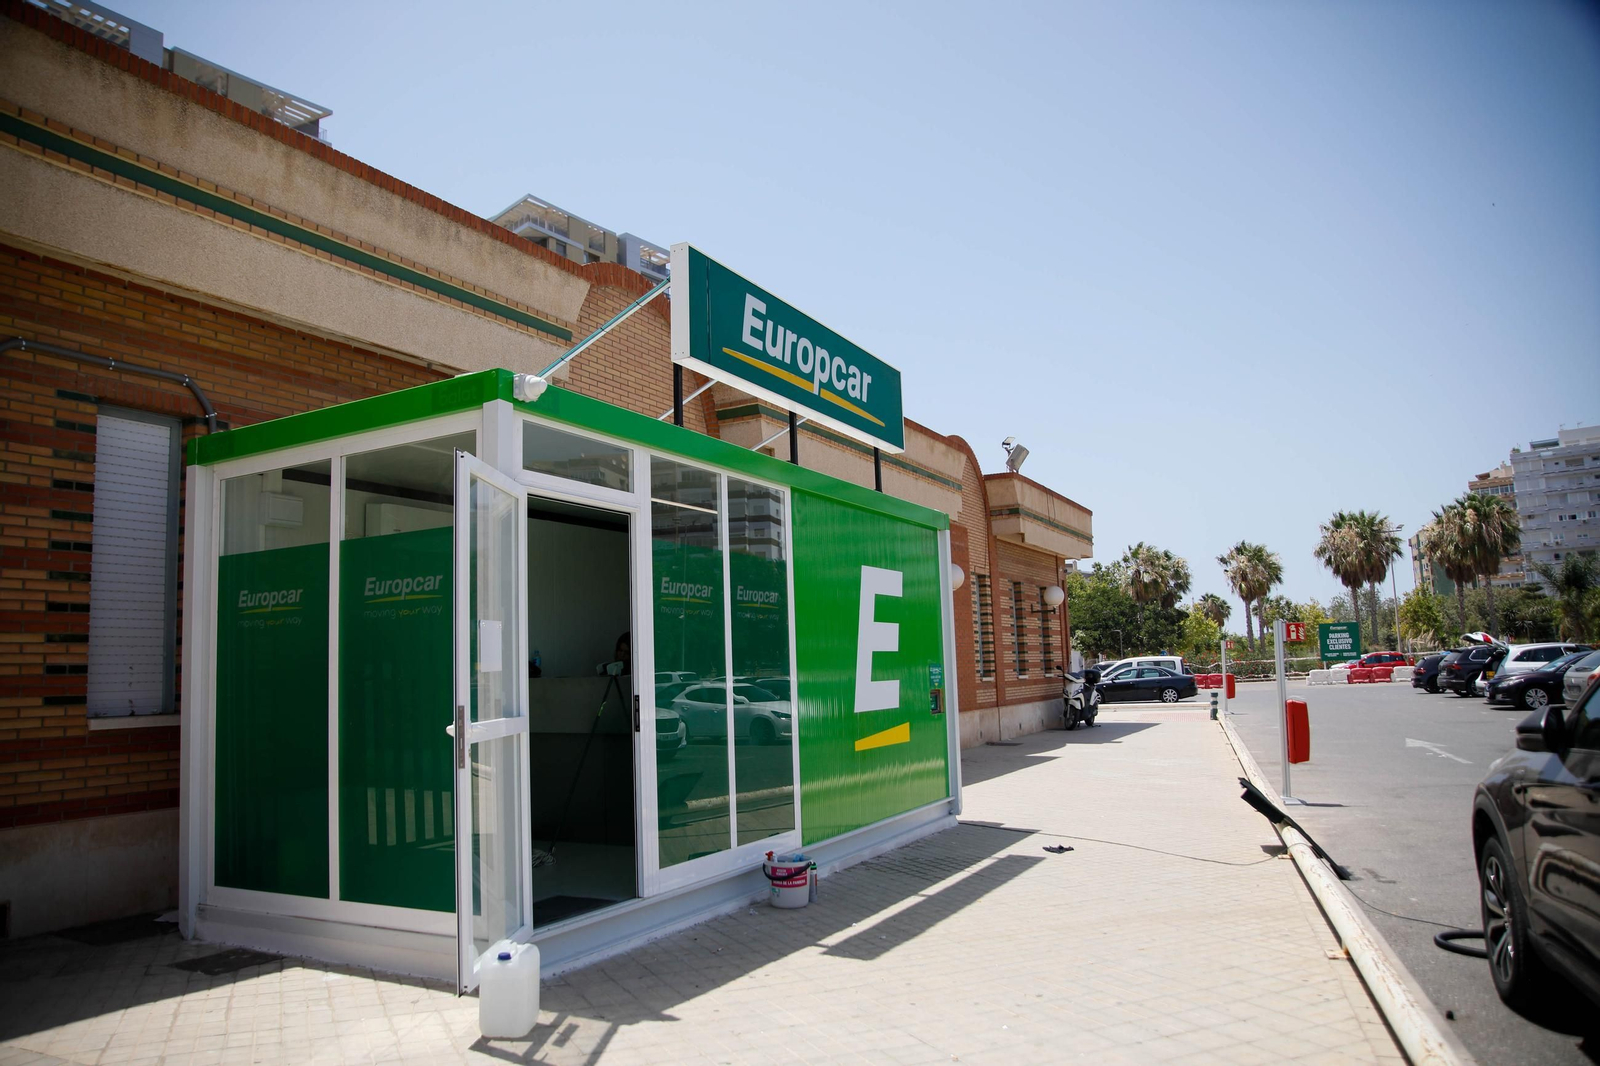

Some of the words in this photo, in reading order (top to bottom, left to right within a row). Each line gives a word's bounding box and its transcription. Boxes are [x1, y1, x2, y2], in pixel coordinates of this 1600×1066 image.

[742, 292, 872, 403] Europcar
[364, 574, 443, 600] Europcar
[661, 577, 713, 601] Europcar
[737, 585, 779, 607] Europcar
[238, 588, 304, 611] Europcar
[237, 619, 265, 629] moving
[265, 618, 284, 628] your
[285, 616, 303, 626] way
[364, 608, 397, 619] moving
[398, 607, 421, 618] your
[421, 605, 443, 616] way
[661, 606, 685, 615] moving
[701, 609, 714, 618] way
[854, 565, 903, 713] E
